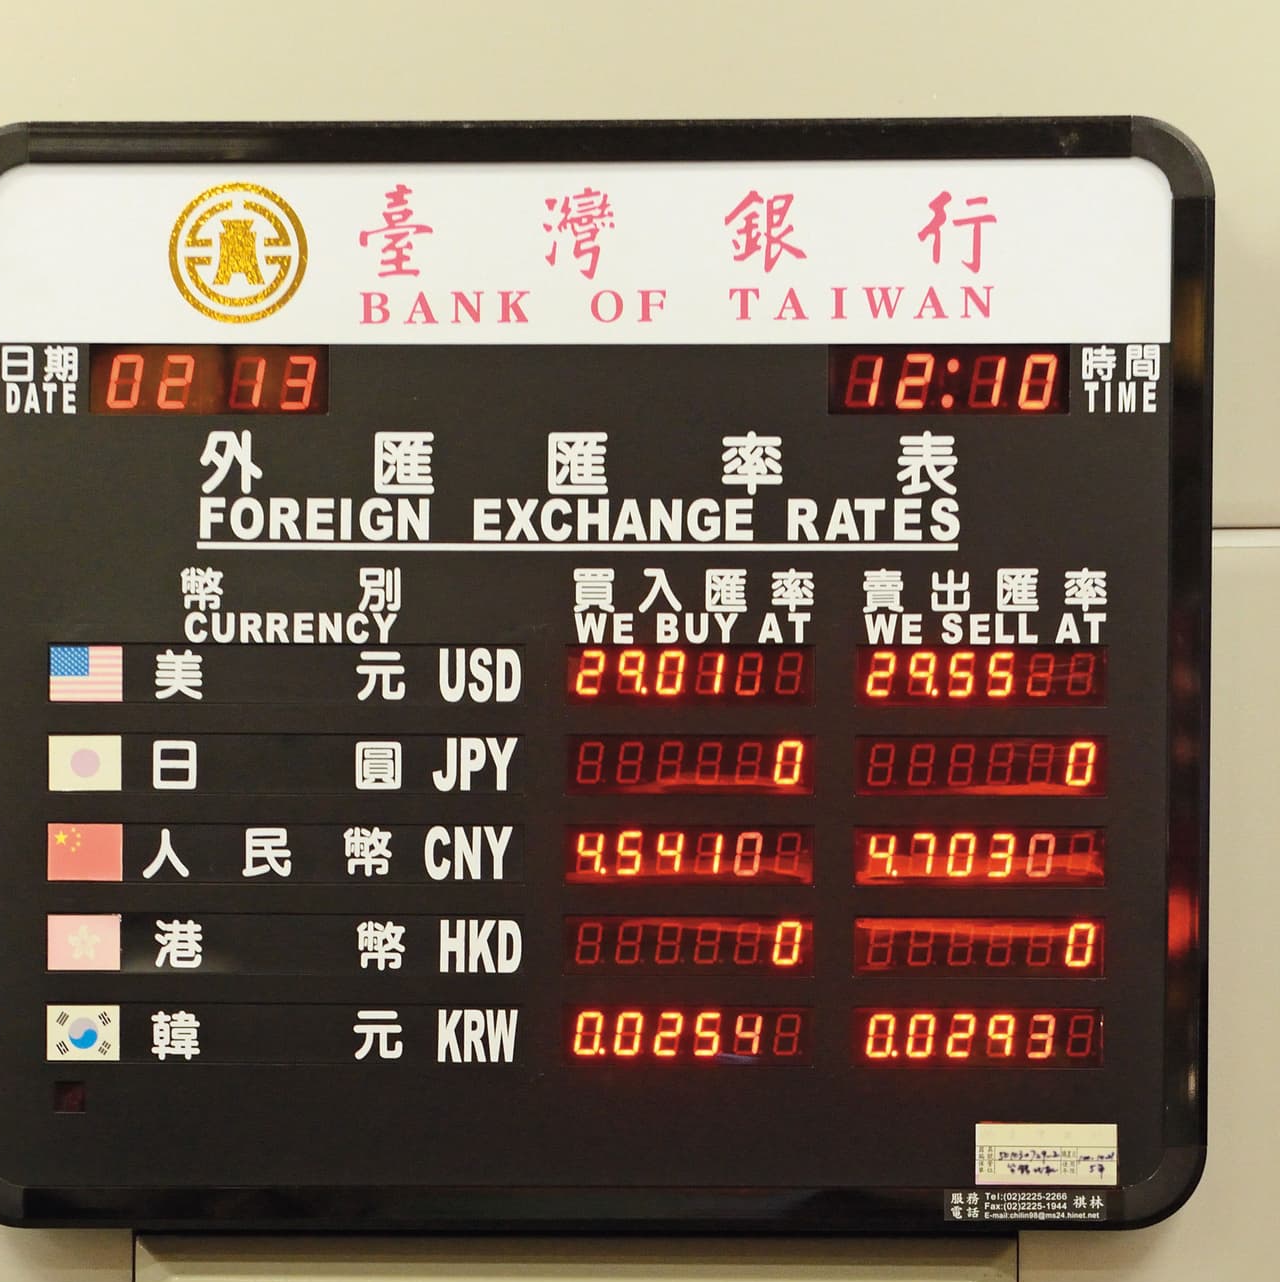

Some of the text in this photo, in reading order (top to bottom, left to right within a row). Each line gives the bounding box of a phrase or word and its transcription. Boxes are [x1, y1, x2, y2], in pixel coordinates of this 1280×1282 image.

[359, 184, 998, 280] 臺灣銀行
[359, 286, 994, 324] BANK OF TAIWAN
[1, 345, 79, 383] 日期
[867, 354, 1058, 410] 12:10
[1081, 345, 1160, 381] 時間
[6, 383, 78, 414] DATE
[1085, 382, 1158, 413] TIME
[200, 429, 959, 496] 外匯匯率表
[199, 497, 961, 542] FOREIGN EXCHANGE RATES
[181, 567, 401, 612] 幣別
[574, 567, 814, 613] 買入匯率
[863, 567, 1108, 613] 賣出匯率
[184, 612, 398, 644] CURRENCY
[574, 613, 813, 645] WE BUY AT
[864, 613, 1107, 645] WE SELL AT
[439, 648, 522, 703] USD
[433, 737, 518, 791] JPY
[424, 826, 513, 881] CNY
[439, 919, 522, 973] HKD
[437, 1009, 518, 1063] KRW
[573, 1011, 762, 1057] 0.0254
[865, 1014, 1054, 1059] 0.0293
